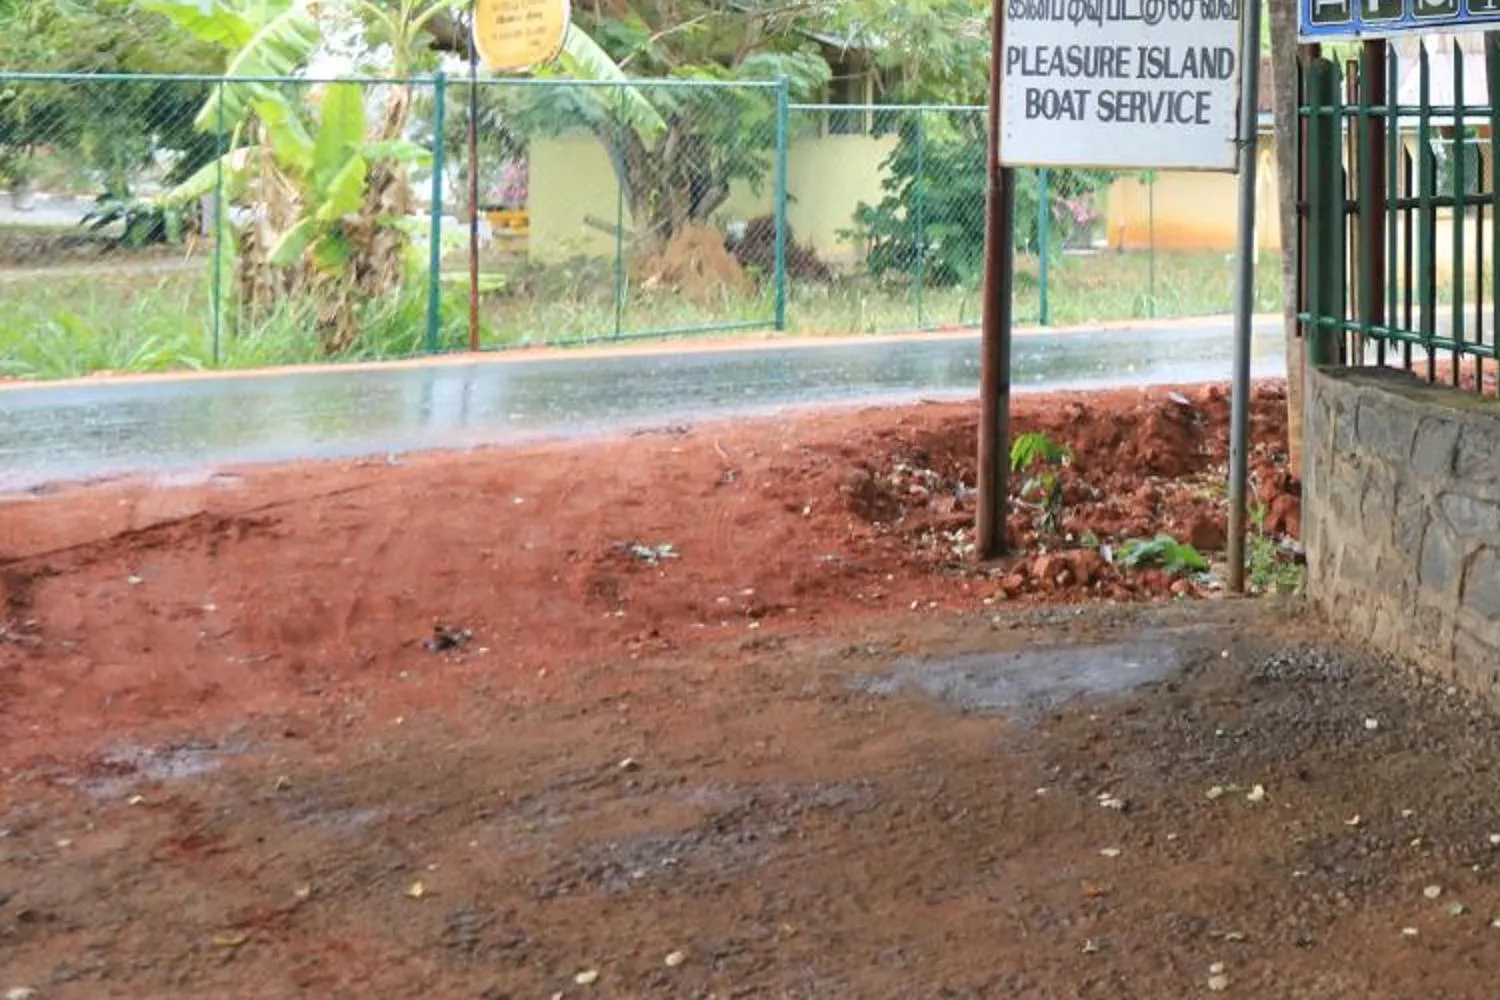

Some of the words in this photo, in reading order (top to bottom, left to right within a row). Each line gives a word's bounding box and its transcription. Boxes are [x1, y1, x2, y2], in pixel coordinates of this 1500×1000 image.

[1006, 46, 1131, 79] PLEASURE
[1136, 46, 1235, 80] ISLAND
[1025, 88, 1092, 121] BOAT
[1096, 90, 1212, 125] SERVICE
